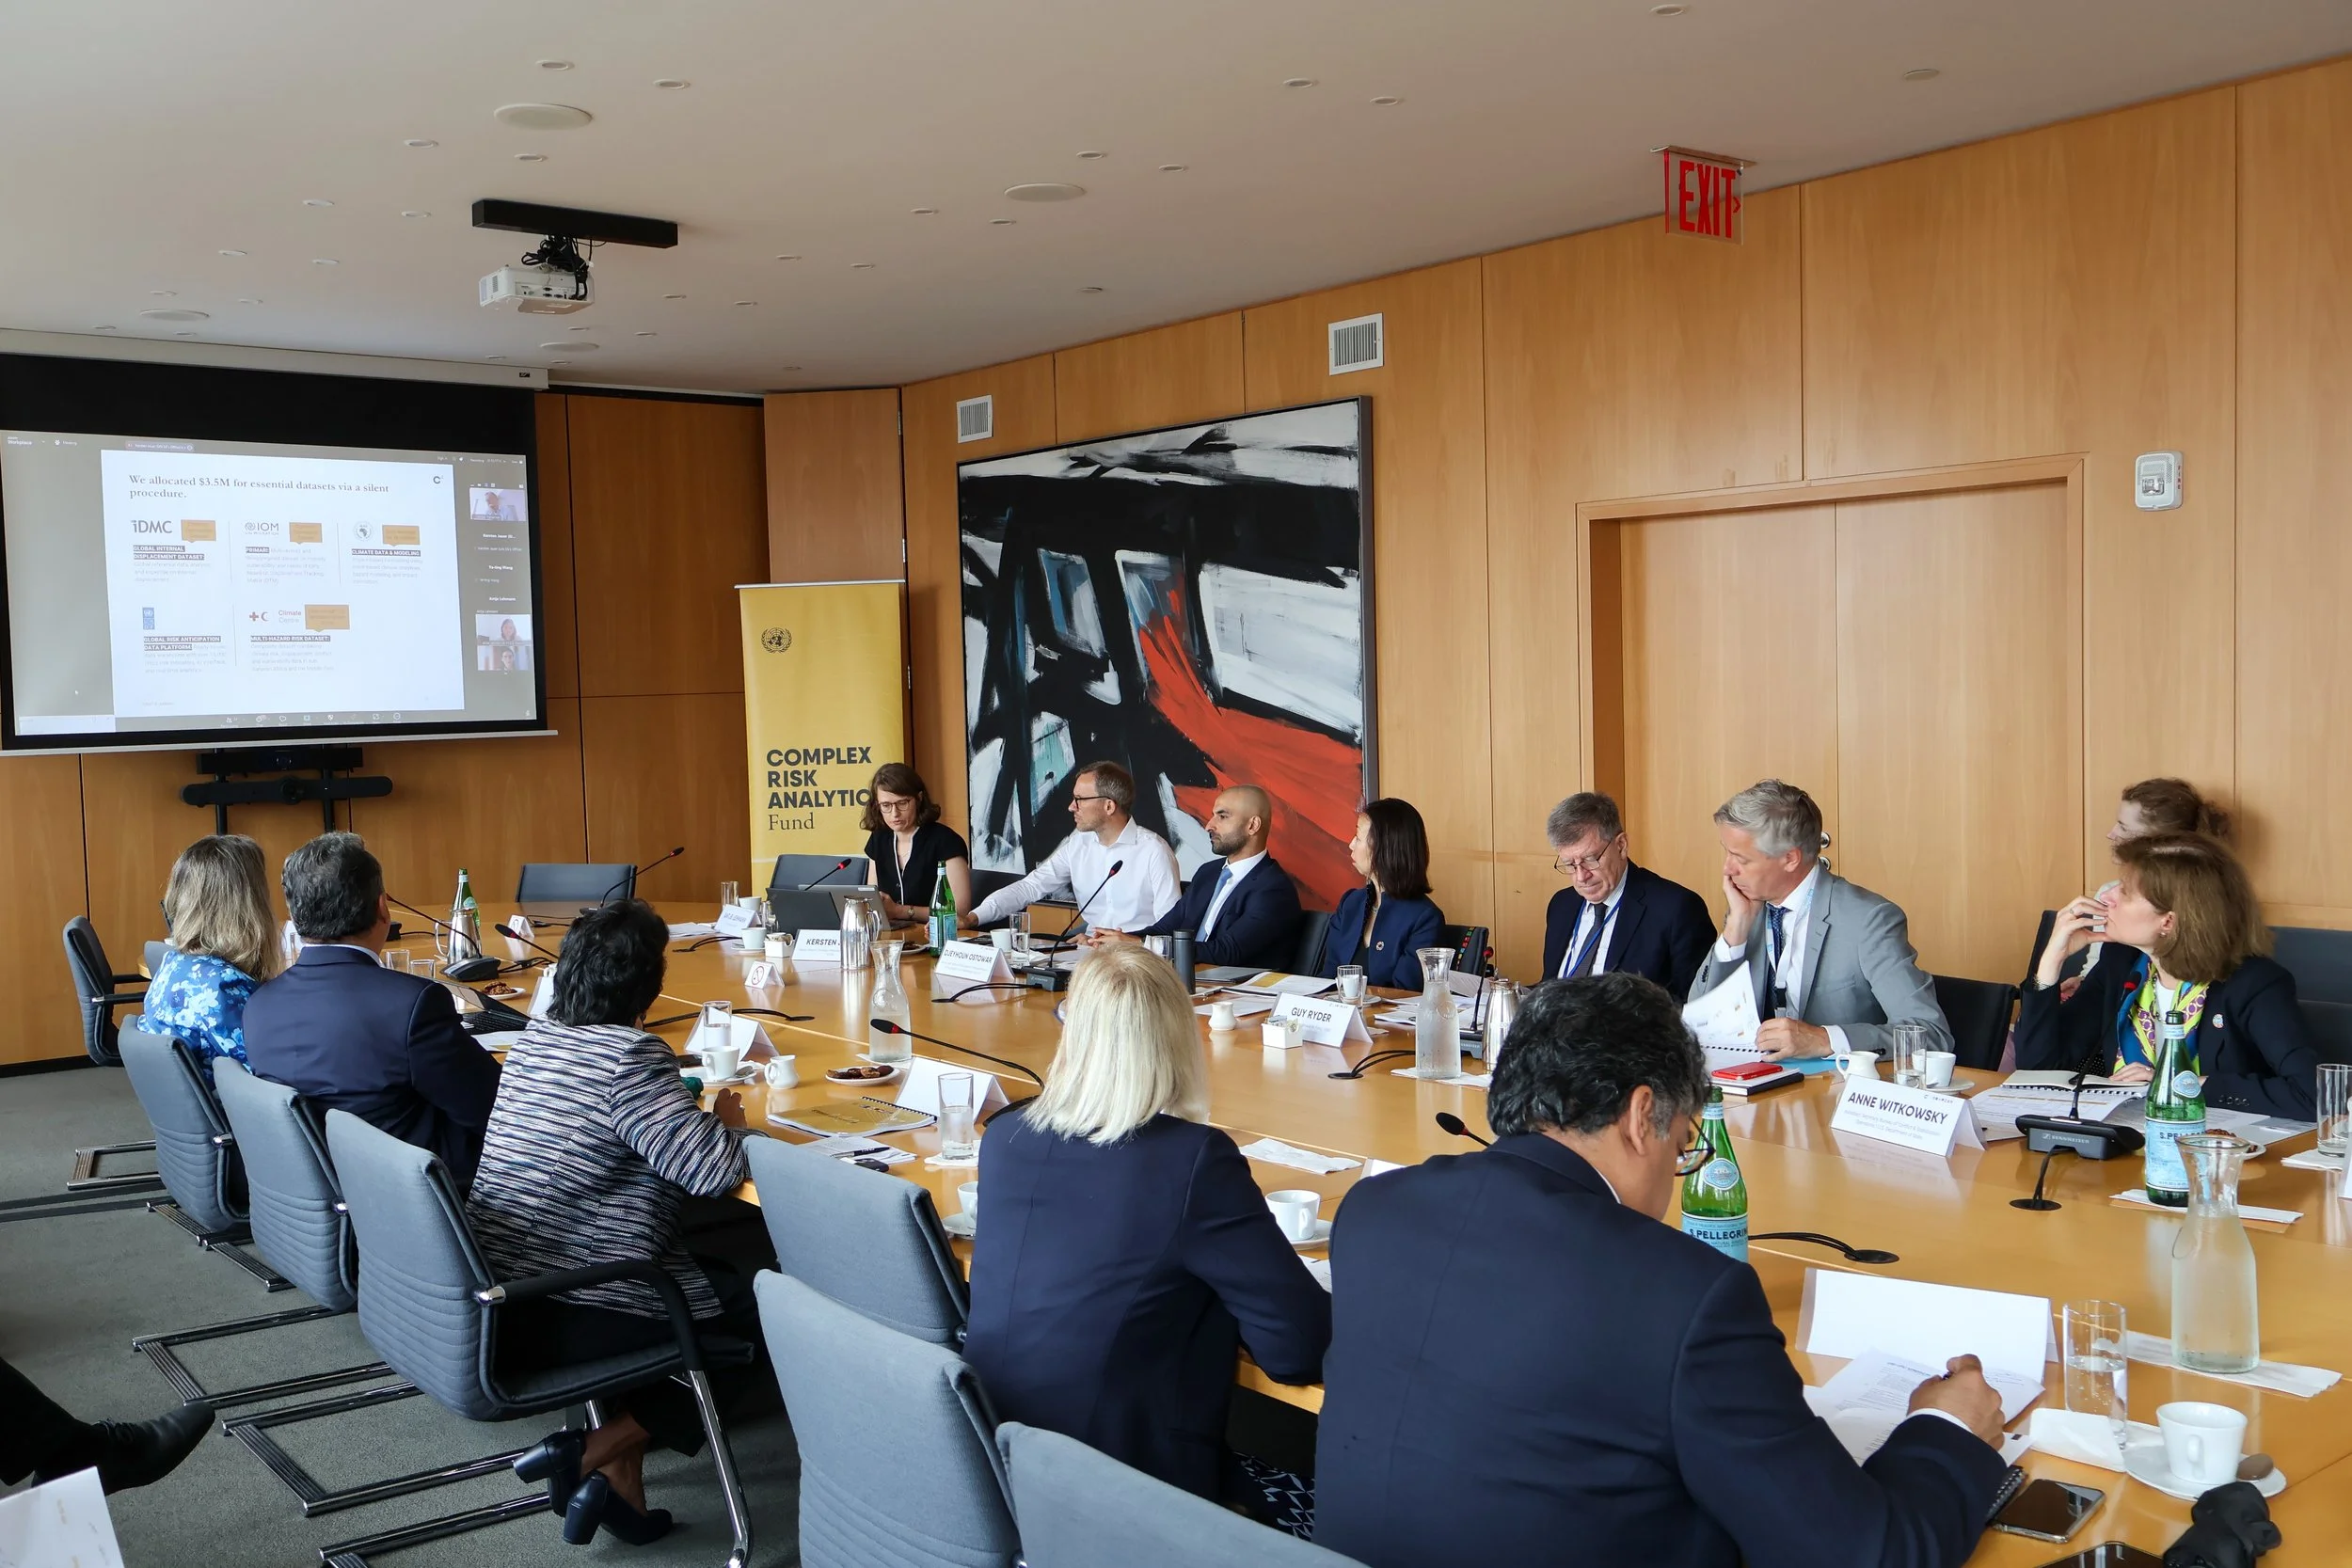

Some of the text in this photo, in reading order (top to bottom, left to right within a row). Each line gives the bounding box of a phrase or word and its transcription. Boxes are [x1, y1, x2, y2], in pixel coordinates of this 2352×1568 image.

[1678, 159, 1736, 239] EXIT
[129, 474, 147, 484] We
[149, 475, 196, 486] allocated
[199, 477, 230, 487] $3.5M
[233, 478, 247, 488] for
[250, 479, 294, 489] essential
[296, 481, 336, 490] datasets
[338, 482, 353, 491] via
[363, 483, 389, 493] silent
[130, 488, 187, 499] procedure.
[257, 522, 279, 531] IOM
[766, 746, 872, 768] COMPLEX
[767, 769, 818, 788] RISK
[768, 812, 816, 831] Fund
[805, 938, 837, 946] KERSTEN
[968, 953, 993, 964] OSTOWAR
[1291, 1006, 1332, 1022] GUY RYDER
[1848, 1092, 1879, 1109] ANNE
[1879, 1098, 1949, 1126] WITKOWSKY
[2051, 1135, 2090, 1145] SENNHEISER
